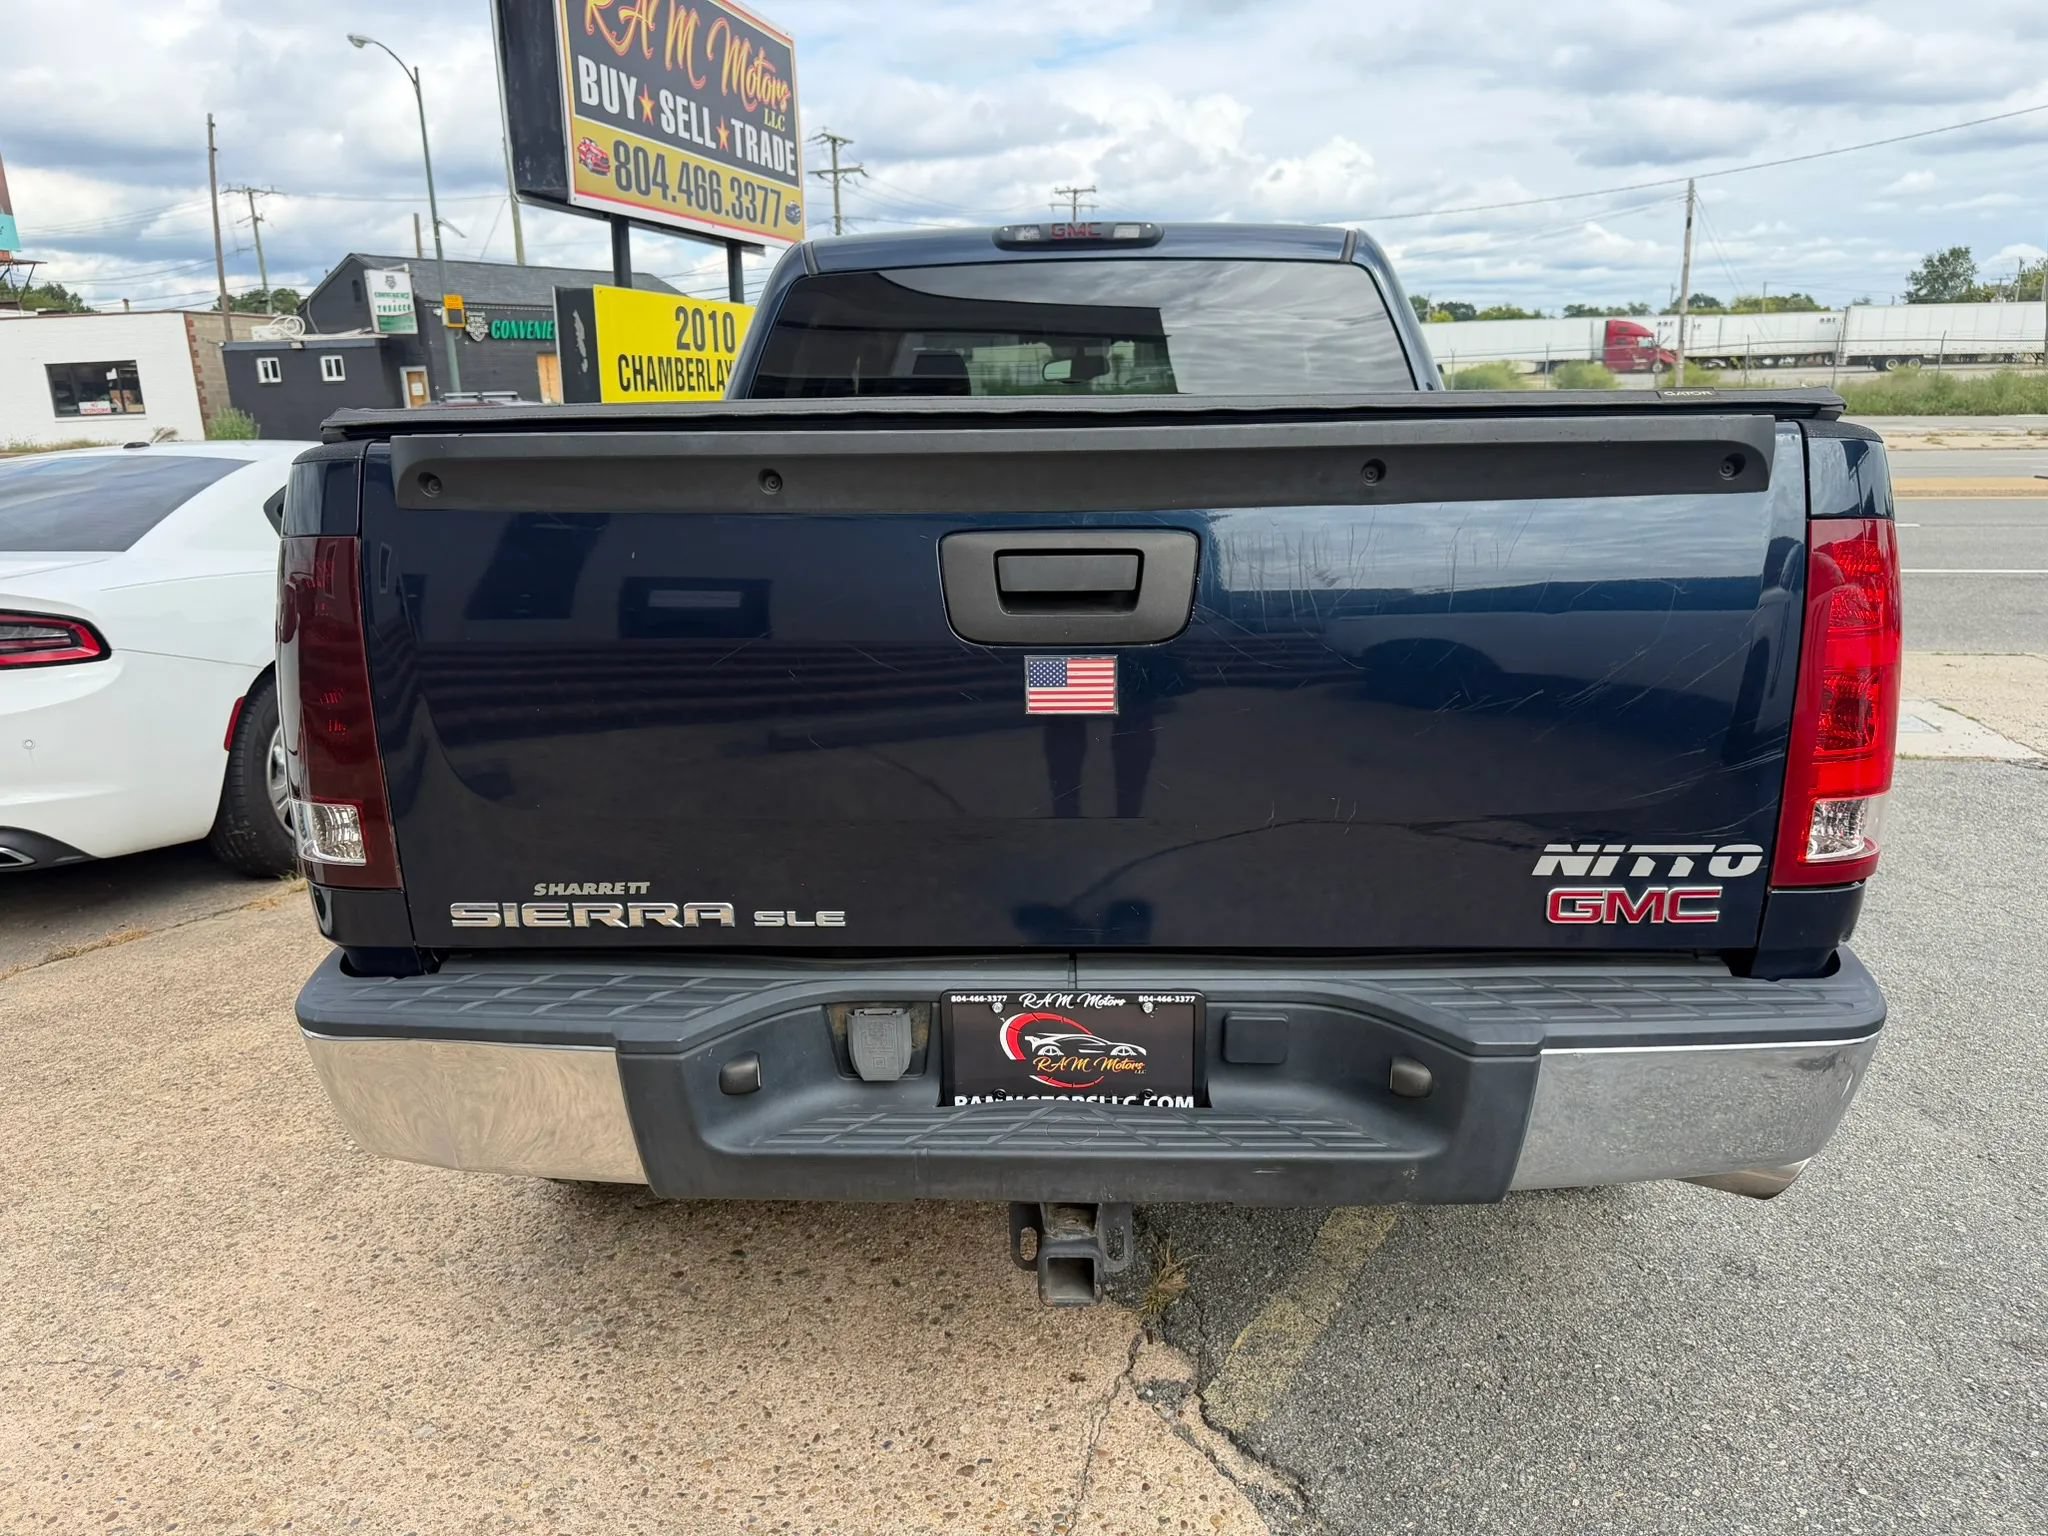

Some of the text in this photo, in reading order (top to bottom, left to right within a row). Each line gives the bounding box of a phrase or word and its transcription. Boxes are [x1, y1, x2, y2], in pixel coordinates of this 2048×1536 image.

[706, 17, 791, 112] Motors
[577, 55, 797, 176] BUY SELL TRADE
[763, 107, 786, 132] LLC
[613, 139, 782, 228] 804.466.3377
[1051, 223, 1102, 239] GMC
[491, 320, 556, 340] CONVENIE
[675, 306, 736, 353] 2010
[617, 353, 735, 392] CHAMBERLAY
[1531, 844, 1764, 877] NITTO
[533, 881, 651, 897] SHARRETT
[449, 902, 847, 929] SIERRA SLE
[1546, 886, 1723, 924] GMC
[951, 995, 1008, 1003] 804-466-3377
[1019, 992, 1127, 1009] RAM Motors
[1138, 995, 1196, 1003] 804-466-3377
[1033, 1056, 1146, 1073] RAM Motors
